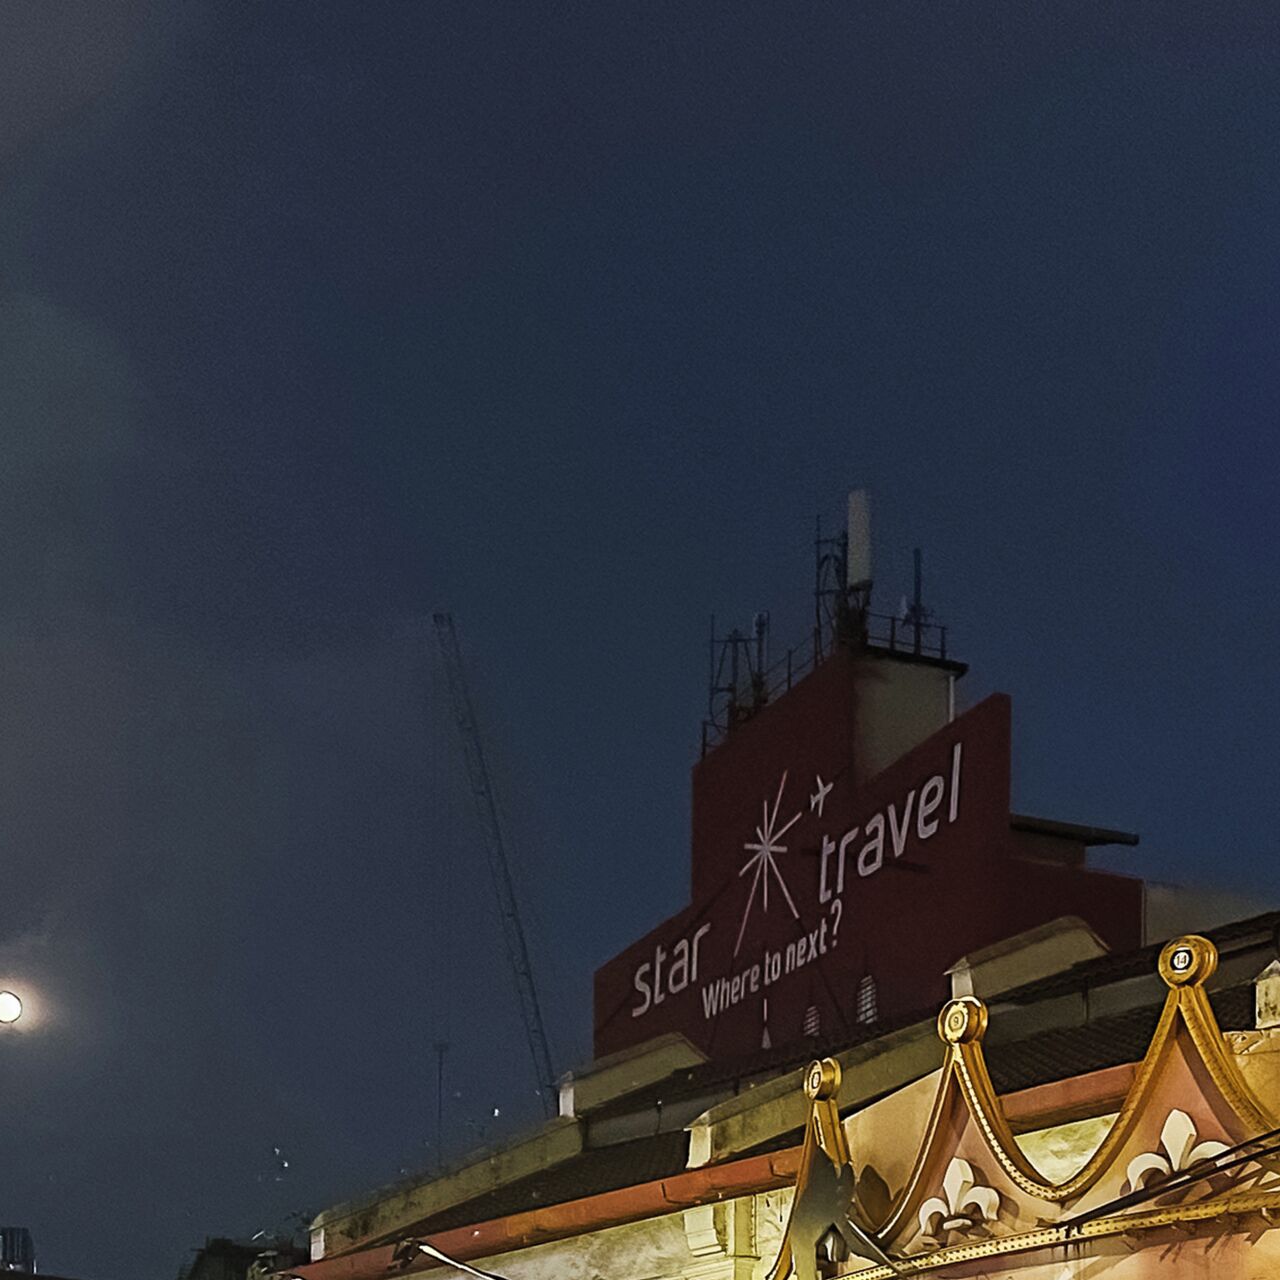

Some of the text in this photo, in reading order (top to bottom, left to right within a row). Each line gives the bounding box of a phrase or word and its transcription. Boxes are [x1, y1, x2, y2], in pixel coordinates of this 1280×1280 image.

[632, 742, 962, 1018] star travel
[702, 967, 760, 1019] Where
[764, 948, 781, 986] to
